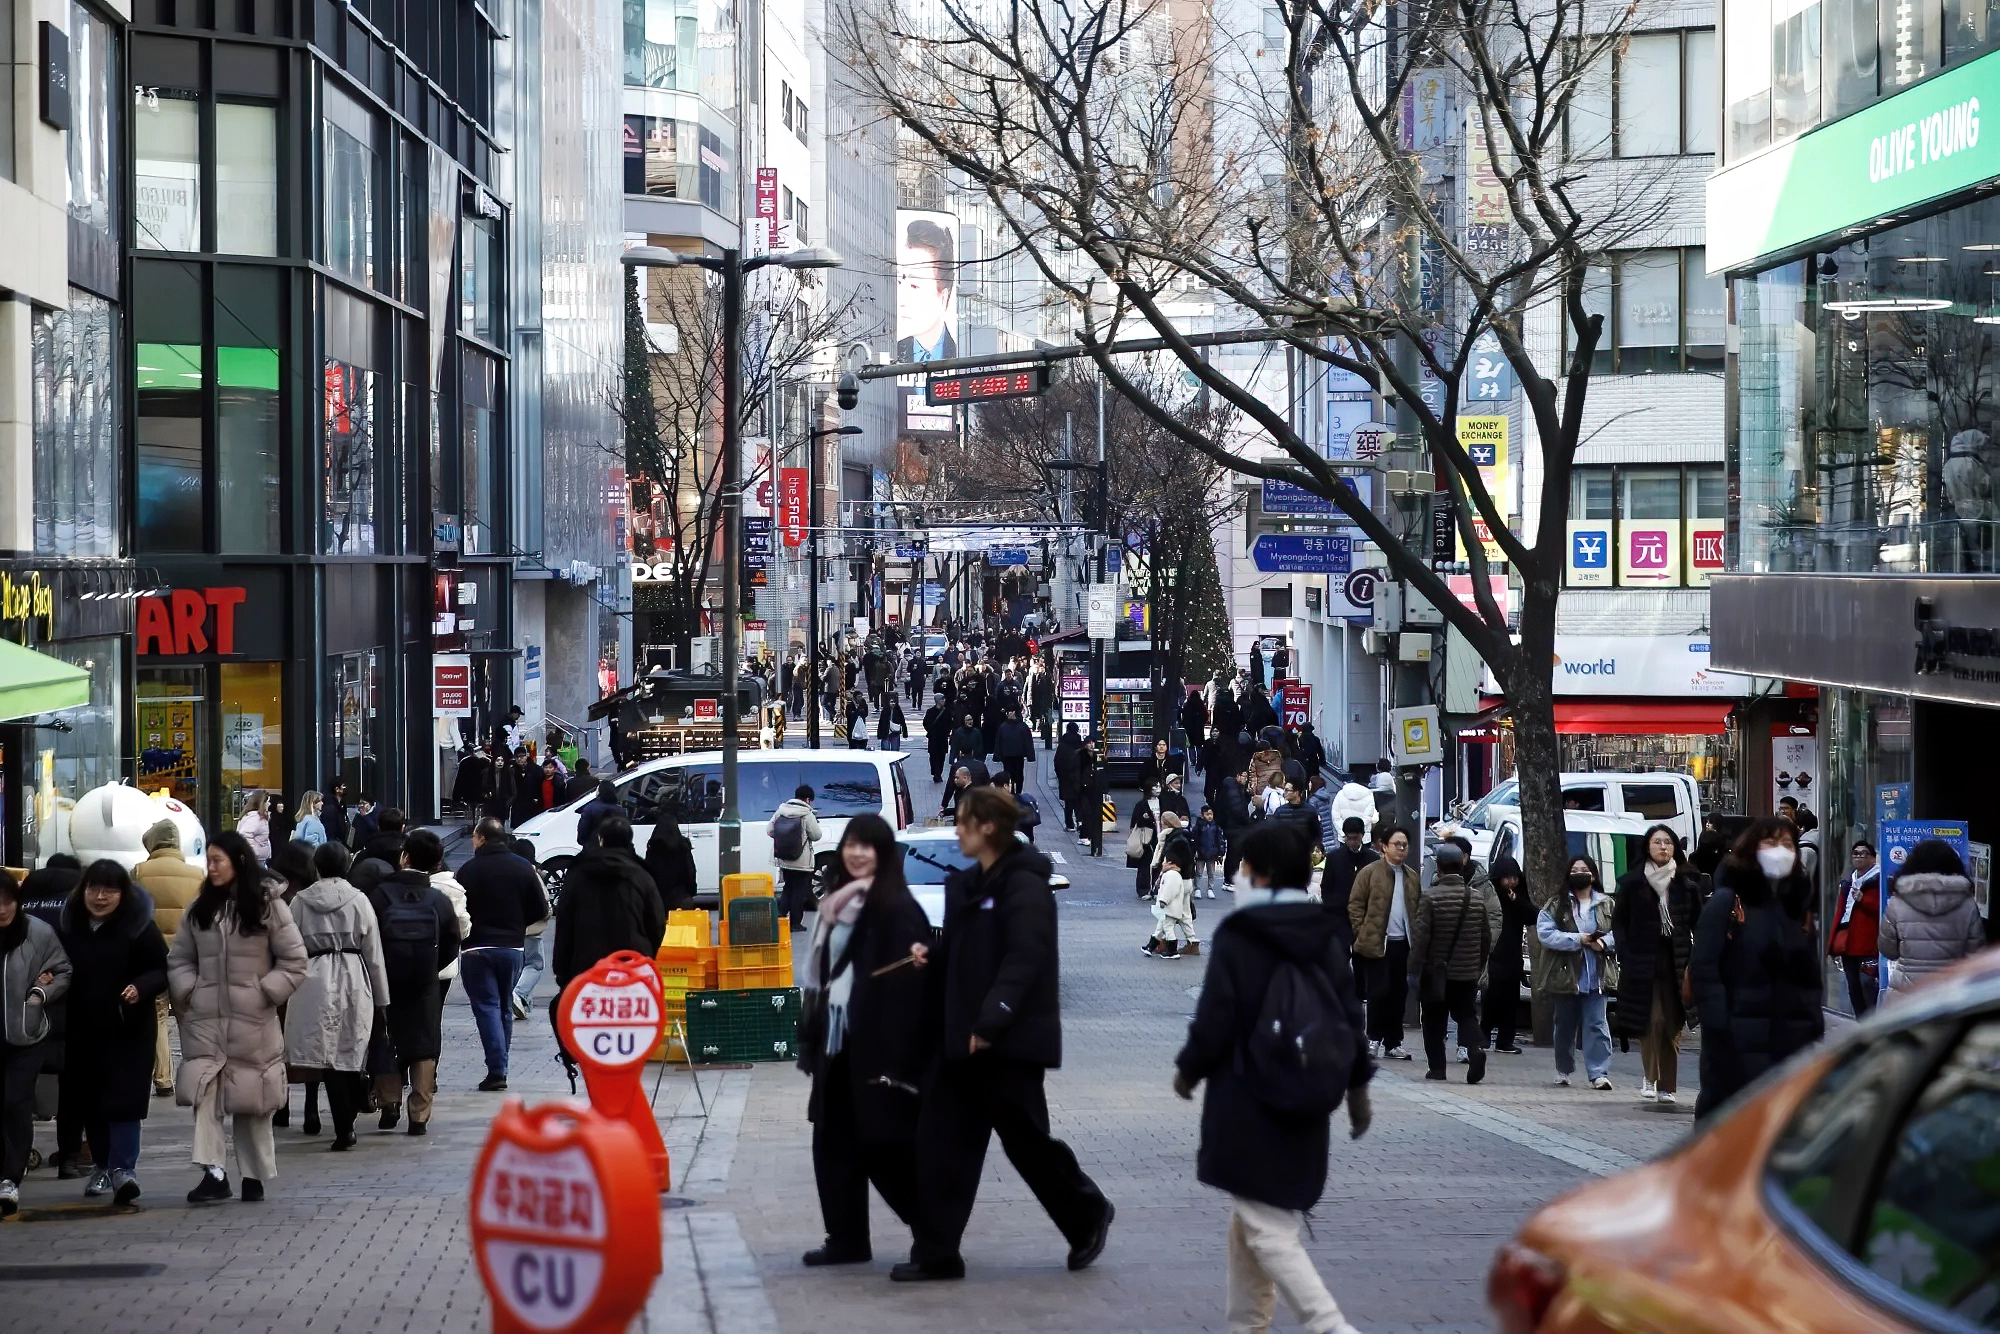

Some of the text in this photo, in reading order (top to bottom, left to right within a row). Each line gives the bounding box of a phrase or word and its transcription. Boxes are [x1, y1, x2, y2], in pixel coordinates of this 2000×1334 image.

[1869, 96, 1980, 184] OLIVE YOUNG
[1333, 416, 1341, 429] 3
[1468, 422, 1498, 430] MONEY
[1461, 431, 1503, 440] EXCHANGE
[789, 477, 799, 495] the
[1265, 493, 1318, 502] Myeongdong
[1303, 539, 1349, 552] 명동10길
[1635, 536, 1664, 564] 元
[1270, 553, 1349, 563] Myeongdong 10-gil
[1564, 658, 1616, 675] world
[1063, 681, 1081, 690] SIM
[1286, 697, 1308, 705] SALE
[1286, 711, 1307, 726] 70
[580, 996, 650, 1019] 주차금지
[593, 1032, 635, 1056] CU
[493, 1168, 596, 1233] 주차금지
[511, 1252, 577, 1308] CU
